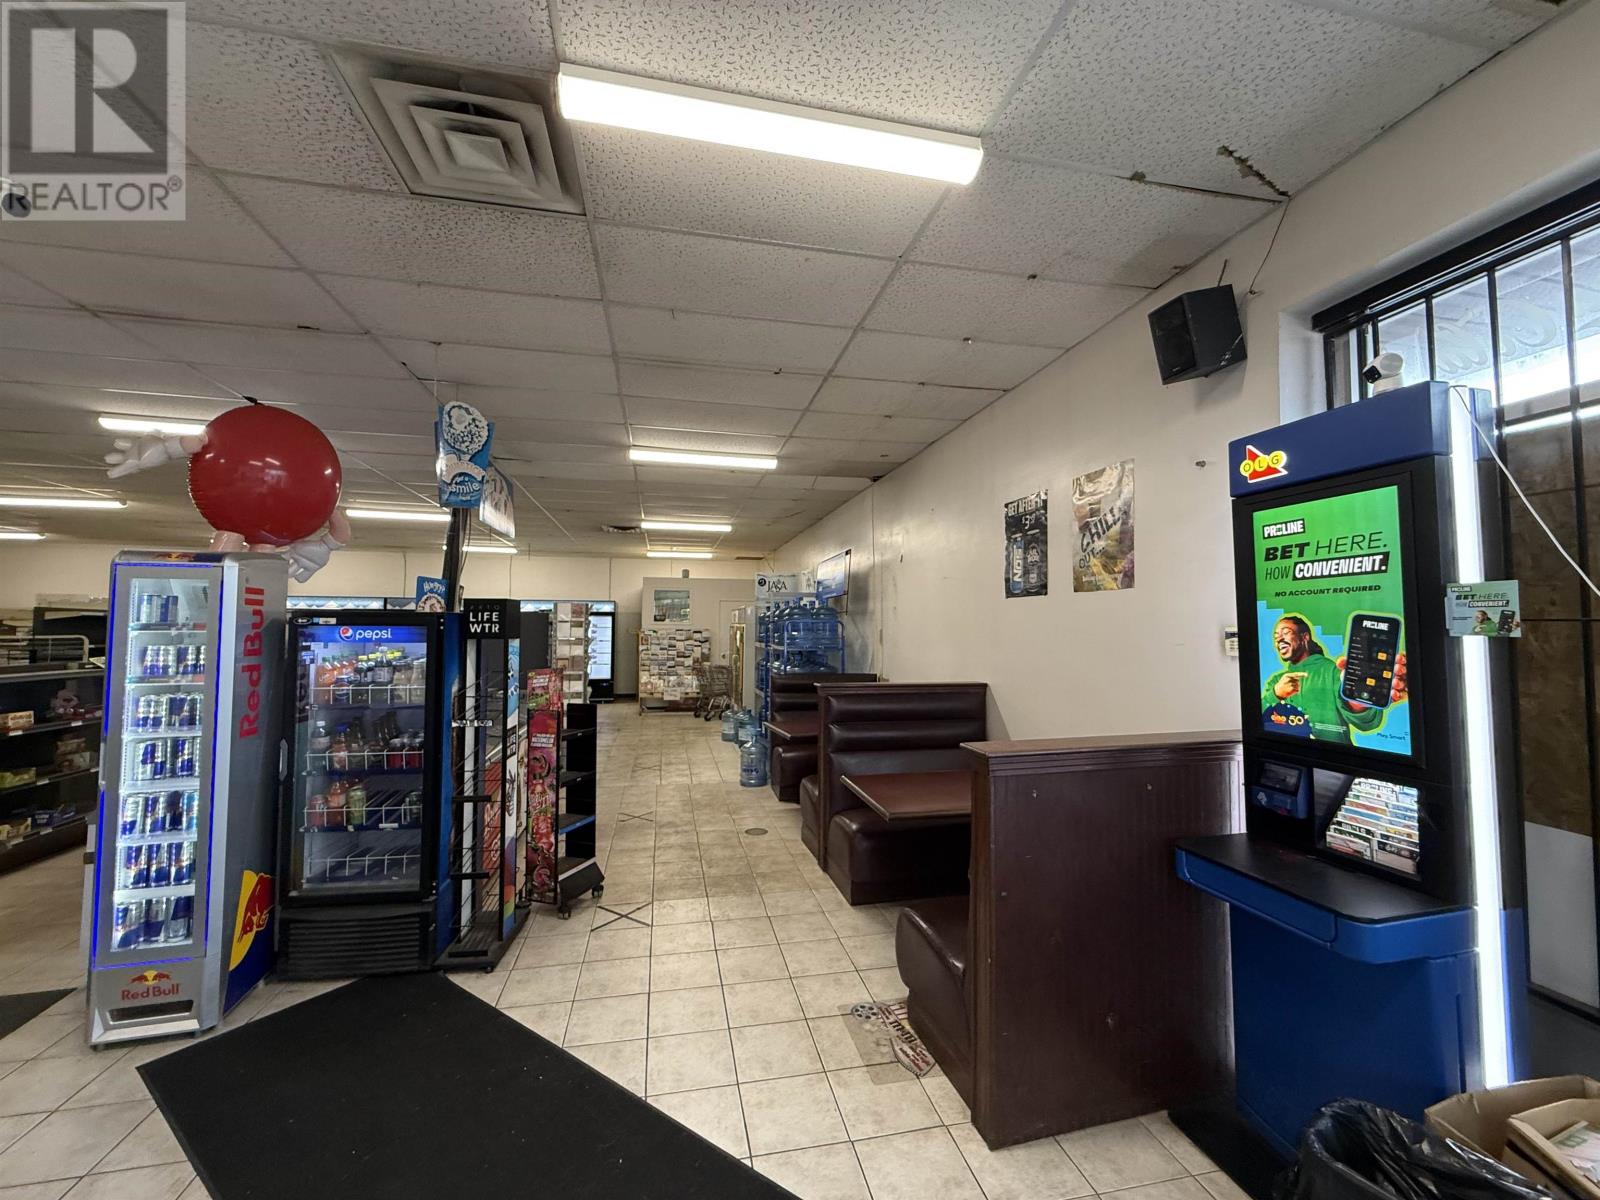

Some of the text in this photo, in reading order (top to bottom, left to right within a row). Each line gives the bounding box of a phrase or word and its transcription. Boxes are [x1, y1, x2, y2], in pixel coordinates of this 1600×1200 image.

[1242, 454, 1280, 473] OLG
[448, 481, 480, 495] smile
[1264, 531, 1388, 562] BET HERE.
[1264, 555, 1387, 581] HOW CONVENIENT.
[1274, 584, 1382, 598] NO ACCOUNT REQUIRED
[469, 611, 500, 623] LIFE
[356, 628, 391, 641] pepsi
[469, 624, 500, 634] WTR
[239, 586, 265, 741] Red Bull
[121, 984, 179, 1001] Red Bull
